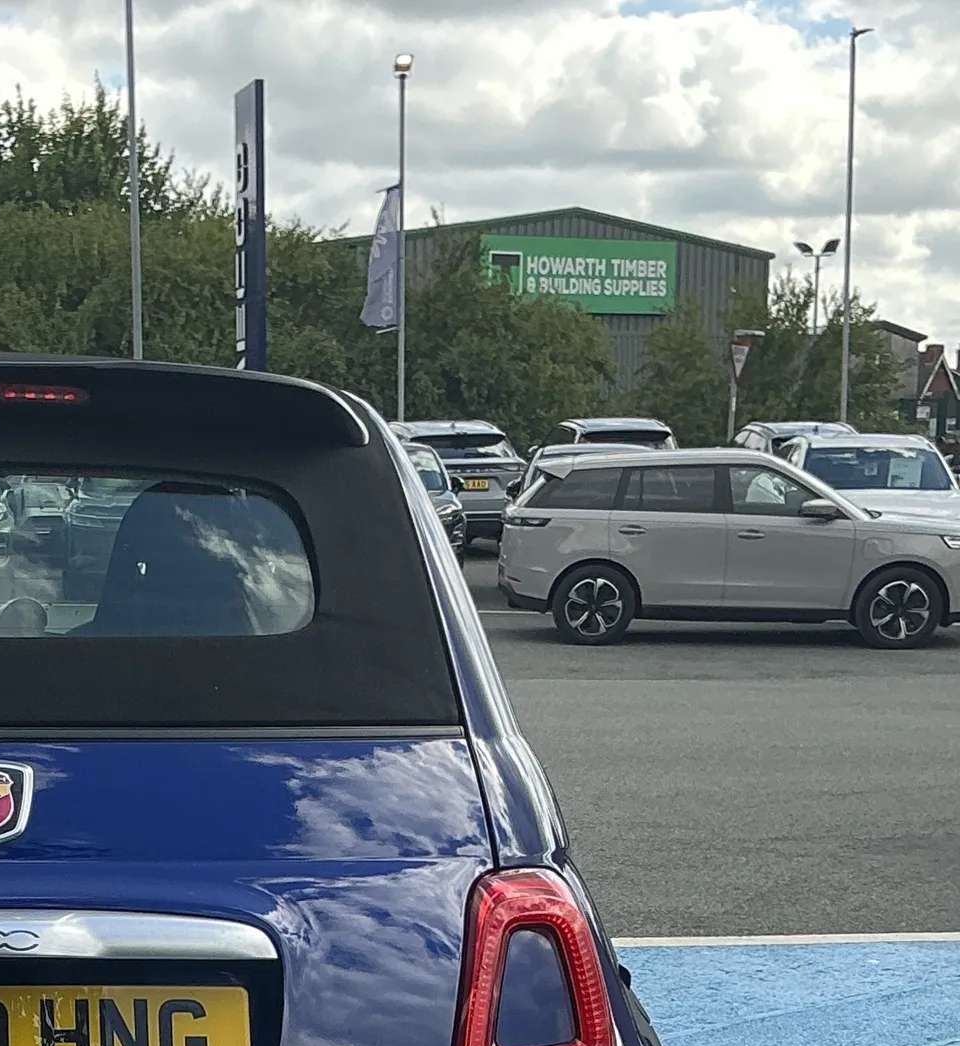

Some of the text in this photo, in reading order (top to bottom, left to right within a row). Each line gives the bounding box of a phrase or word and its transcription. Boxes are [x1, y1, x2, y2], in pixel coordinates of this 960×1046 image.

[526, 255, 667, 279] HOWARTH TIMBER
[526, 276, 667, 297] & BUILDING SUPPLIES
